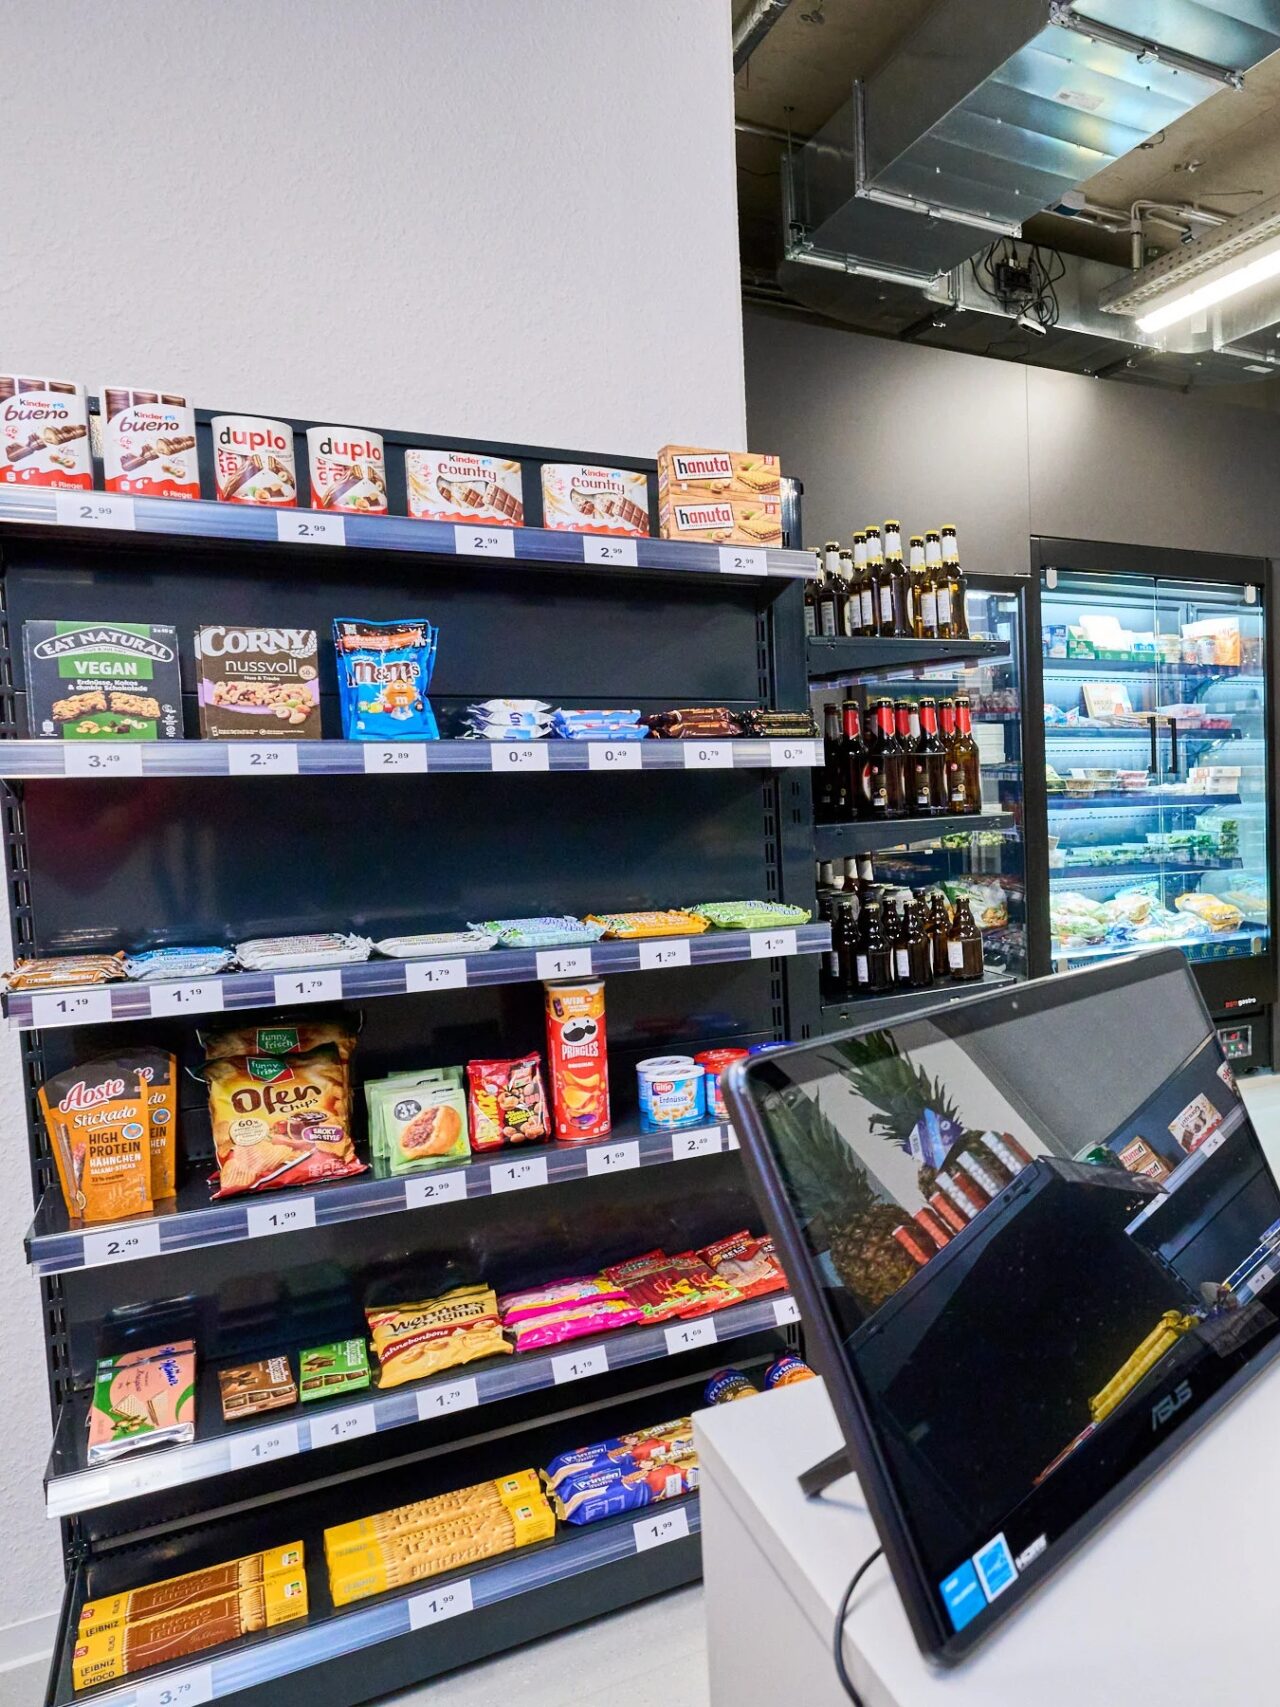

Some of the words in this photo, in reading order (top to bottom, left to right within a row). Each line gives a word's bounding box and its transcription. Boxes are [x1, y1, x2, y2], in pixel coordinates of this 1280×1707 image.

[4, 405, 68, 421] bueno
[119, 417, 179, 433] bueno
[219, 427, 287, 453] duplo
[319, 437, 382, 461] duplo
[449, 453, 480, 466] Kinder
[677, 457, 729, 474] hanuta
[437, 463, 497, 483] Country
[581, 468, 610, 479] Kinder
[571, 477, 625, 495] Country
[80, 505, 112, 520] 2.99
[679, 507, 731, 525] hanuta
[297, 524, 326, 537] 2.99
[474, 537, 498, 549] 2.99
[600, 547, 623, 559] 2.99
[734, 557, 754, 568] 2.99
[42, 636, 75, 655] EAT
[80, 631, 166, 659] NATURAL
[201, 626, 309, 657] CORNY
[74, 661, 138, 675] VEGAN
[225, 659, 297, 674] nussvoll
[88, 754, 120, 768] 3.49
[250, 753, 278, 766] 2.29
[509, 750, 532, 763] 0.49
[605, 750, 627, 761] 0.49
[699, 750, 719, 761] 0.79
[655, 951, 676, 963] 1.29
[554, 960, 576, 972] 1.39
[424, 969, 449, 982] 1.79
[295, 981, 323, 994] 1.79
[173, 989, 201, 1002] 1.19
[56, 998, 88, 1013] 1.19
[265, 1038, 293, 1049] frisch
[562, 1042, 598, 1060] PRINGLES
[59, 1079, 125, 1113] Aoste
[231, 1085, 322, 1114] Ofen
[279, 1099, 318, 1114] Chips
[397, 1103, 420, 1118] 3x
[74, 1106, 137, 1128] Stickado
[89, 1132, 118, 1144] HIGH
[90, 1142, 140, 1157] PROTEIN
[507, 1166, 530, 1180] 1.19
[424, 1183, 450, 1198] 2.99
[268, 1211, 296, 1226] 1.99
[107, 1239, 139, 1255] 2.49
[570, 1361, 592, 1375] 1.19
[435, 1391, 460, 1406] 1.79
[331, 1419, 357, 1435] 1.99
[251, 1440, 280, 1457] 1.99
[565, 1448, 604, 1463] Prinzen
[579, 1471, 619, 1488] Prinzen
[650, 1522, 673, 1537] 1.99
[428, 1595, 454, 1613] 1.99
[86, 1621, 119, 1637] LEIBNIZ
[81, 1659, 115, 1677] LEIBNIZ
[83, 1671, 115, 1686] CHOCO
[160, 1684, 191, 1706] 3.79
